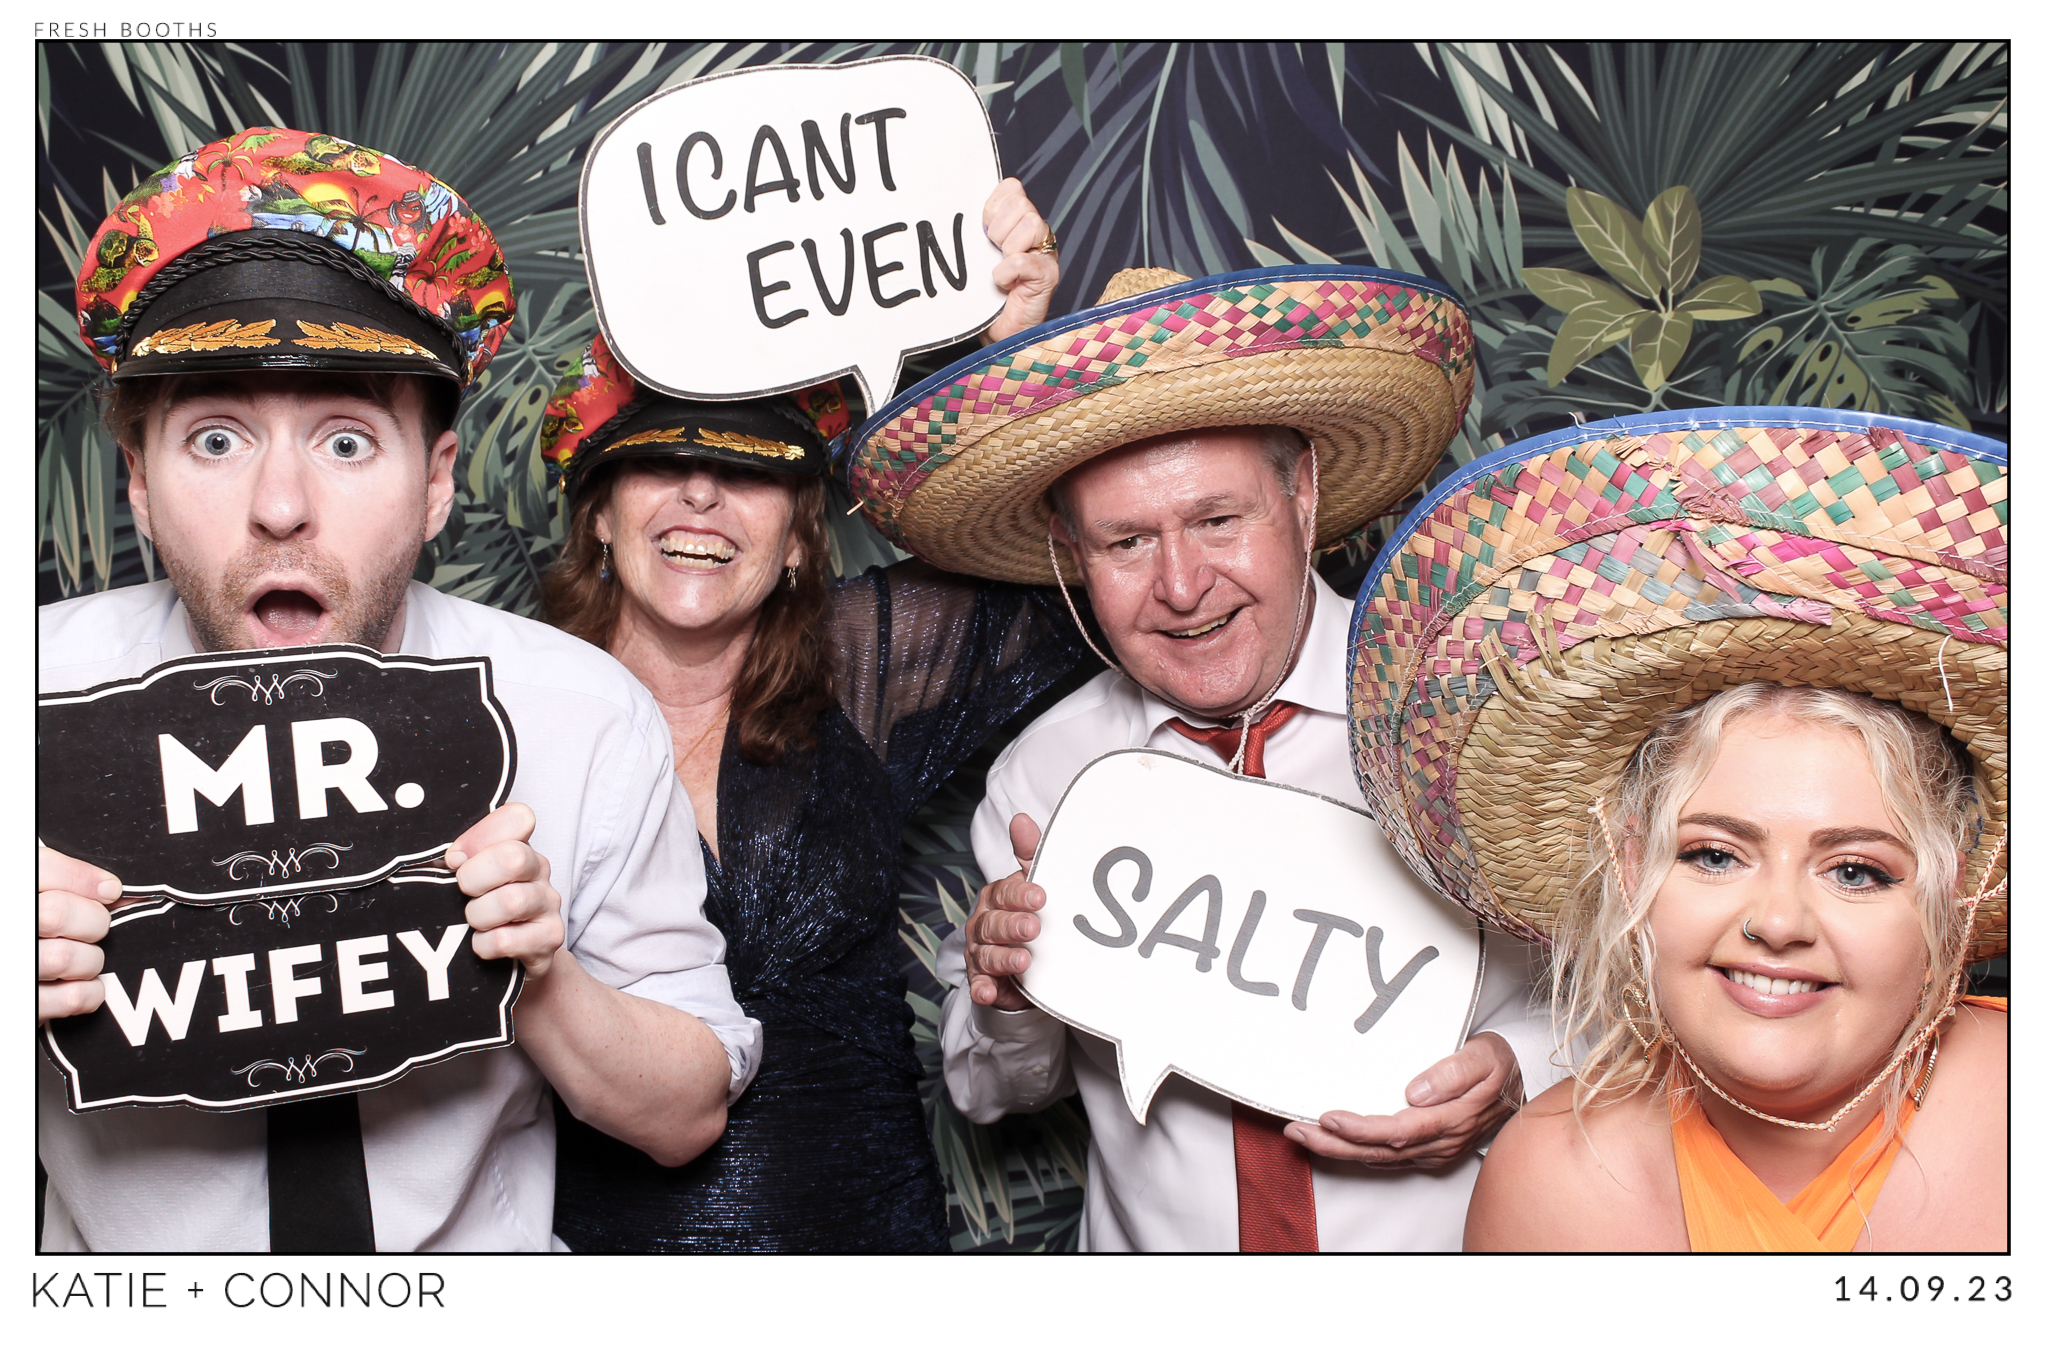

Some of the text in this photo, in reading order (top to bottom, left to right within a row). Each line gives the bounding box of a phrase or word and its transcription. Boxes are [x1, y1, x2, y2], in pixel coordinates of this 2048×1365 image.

[636, 107, 907, 225] I CANT
[746, 212, 968, 329] EVEN
[158, 717, 425, 835] MR.
[99, 923, 470, 1048] WIFEY
[1072, 845, 1440, 1035] SALTY
